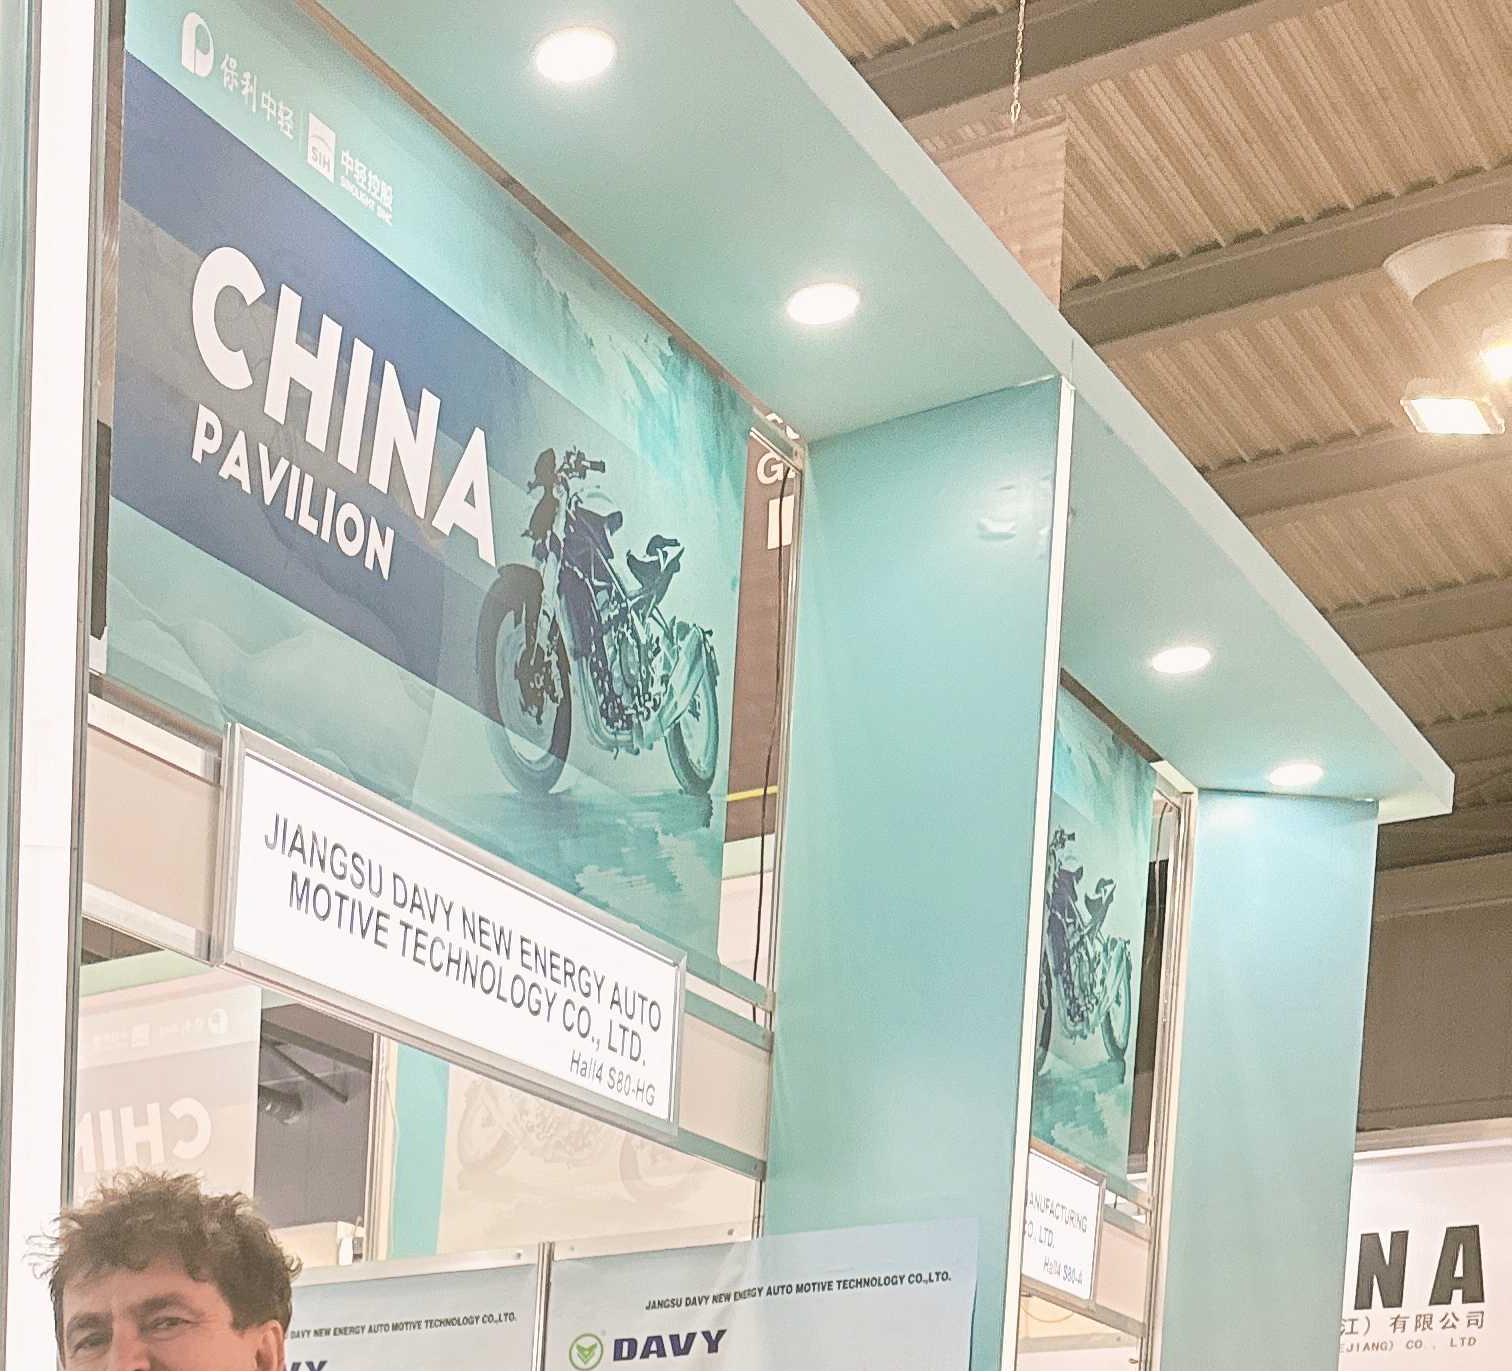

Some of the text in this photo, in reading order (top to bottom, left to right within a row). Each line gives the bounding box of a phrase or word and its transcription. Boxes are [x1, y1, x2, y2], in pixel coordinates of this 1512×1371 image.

[191, 246, 496, 567] CHINA
[191, 404, 395, 580] PAVILION
[263, 812, 663, 1033] JIANGSU DAVY NEW ENERGY AUTO
[289, 871, 646, 1067] MOTIVE TECHNOLOGY CO., LTD.
[570, 1050, 656, 1108] Hall4 S80-HG
[367, 1323, 389, 1334] AUTO
[613, 1329, 728, 1362] DAVY
[685, 1294, 709, 1307] DAVY
[712, 1291, 731, 1305] NEW
[766, 1283, 793, 1298] AUTO
[795, 1279, 834, 1295] MOTIVE
[836, 1274, 906, 1291] TECHNOLOGY
